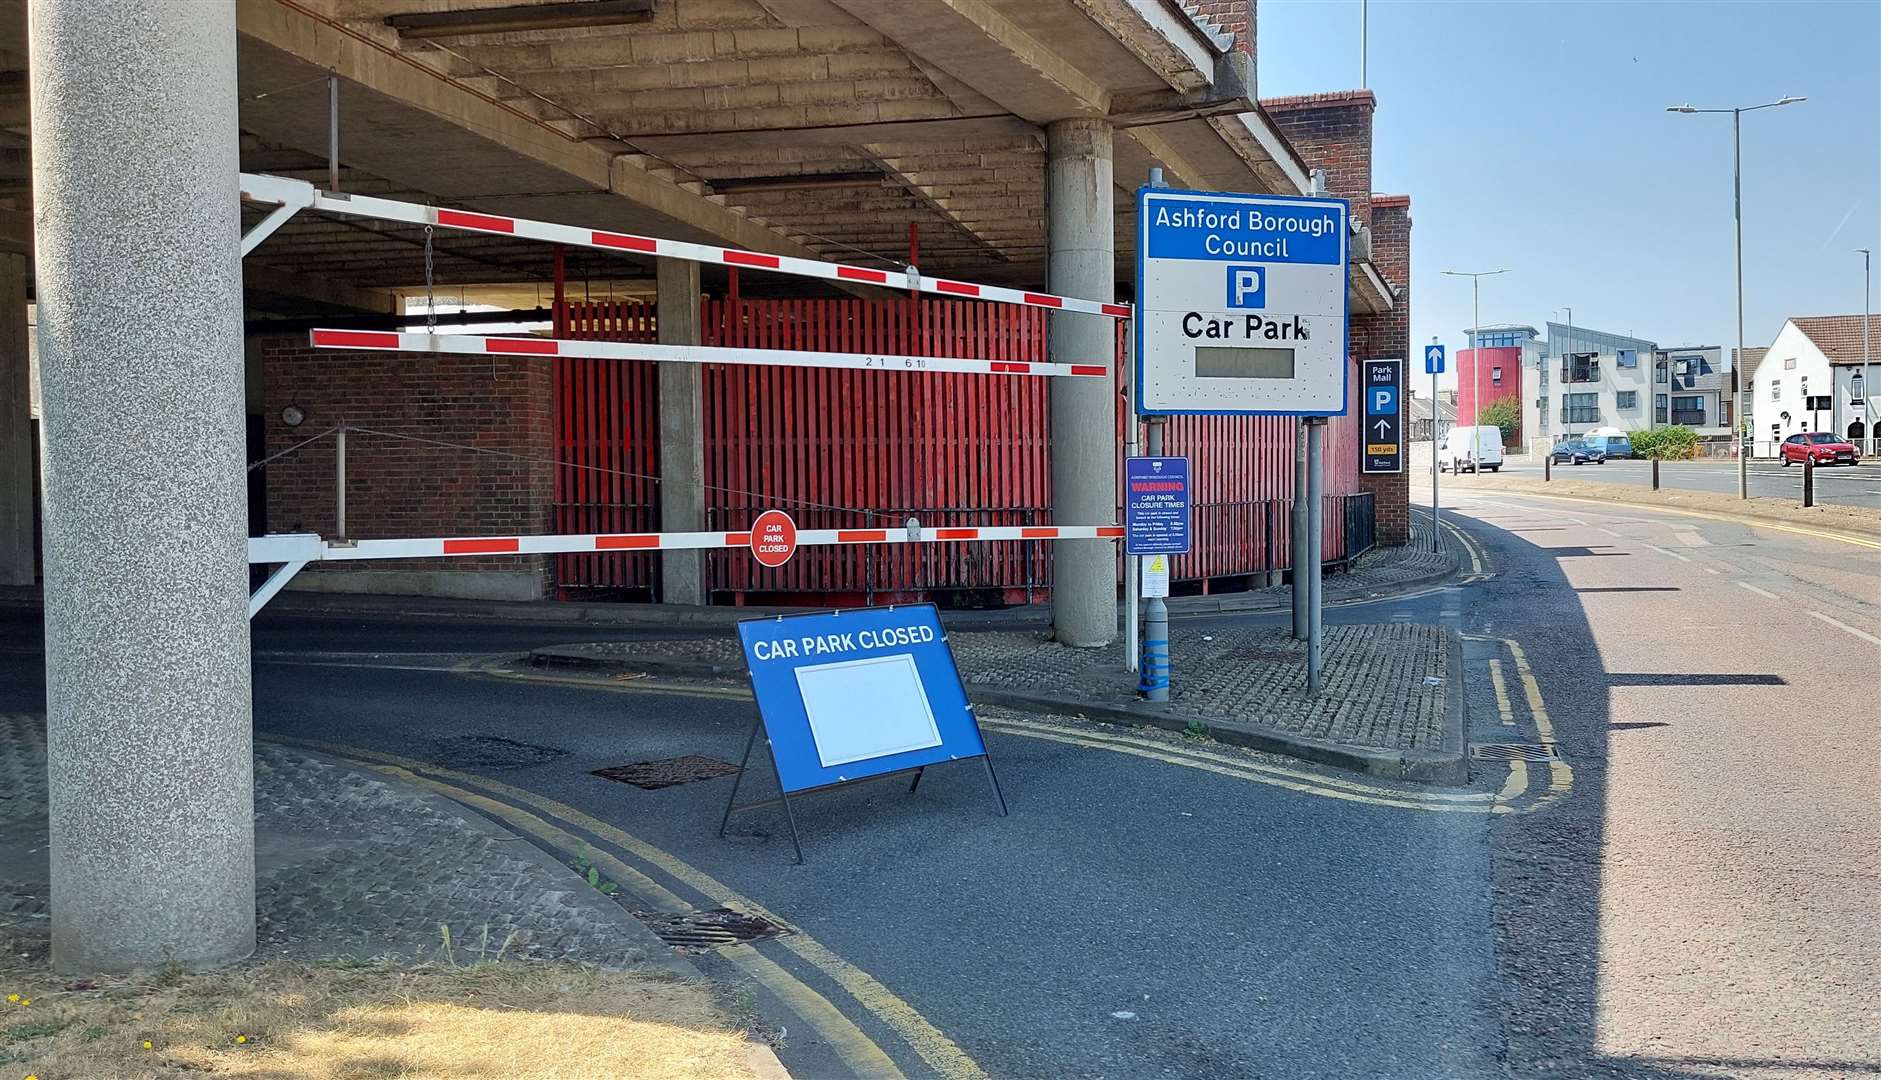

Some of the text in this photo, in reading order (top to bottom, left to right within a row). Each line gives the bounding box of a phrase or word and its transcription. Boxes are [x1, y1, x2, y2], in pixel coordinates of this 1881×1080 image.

[1155, 206, 1335, 237] Ashford Borough
[1205, 235, 1289, 257] Council
[1235, 270, 1260, 306] P
[1182, 311, 1309, 341] Car Park
[1372, 365, 1393, 374] Park
[1373, 374, 1392, 382] Mall
[1375, 391, 1391, 411] P
[1131, 482, 1184, 492] WARNING
[766, 524, 782, 532] CAR
[753, 625, 934, 661] CAR PARK CLOSED
